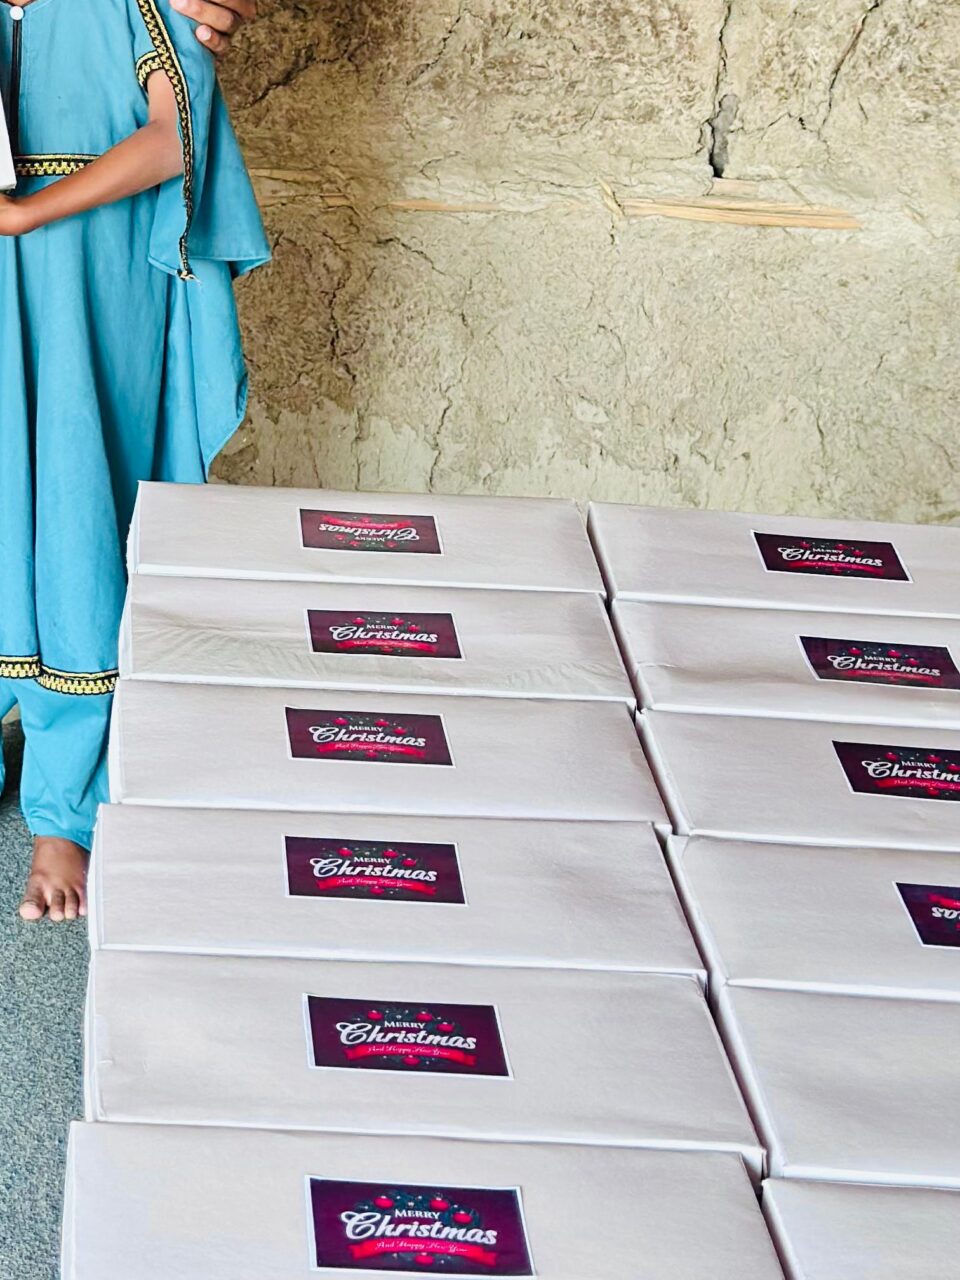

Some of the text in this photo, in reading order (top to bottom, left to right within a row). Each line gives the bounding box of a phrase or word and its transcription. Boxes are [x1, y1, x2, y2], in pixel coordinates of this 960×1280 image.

[319, 523, 420, 541] Christmas
[777, 547, 883, 567] Christmas
[329, 625, 438, 643] Christmas
[826, 654, 941, 677] Christmas
[308, 726, 426, 747] Christmas
[902, 760, 937, 769] MERRY
[309, 857, 438, 882] Christmas
[353, 856, 392, 864] MERRY
[384, 1021, 426, 1029] MERRY
[335, 1022, 477, 1050] Christmas
[394, 1207, 441, 1219] MERRY
[340, 1211, 498, 1246] Christmas
